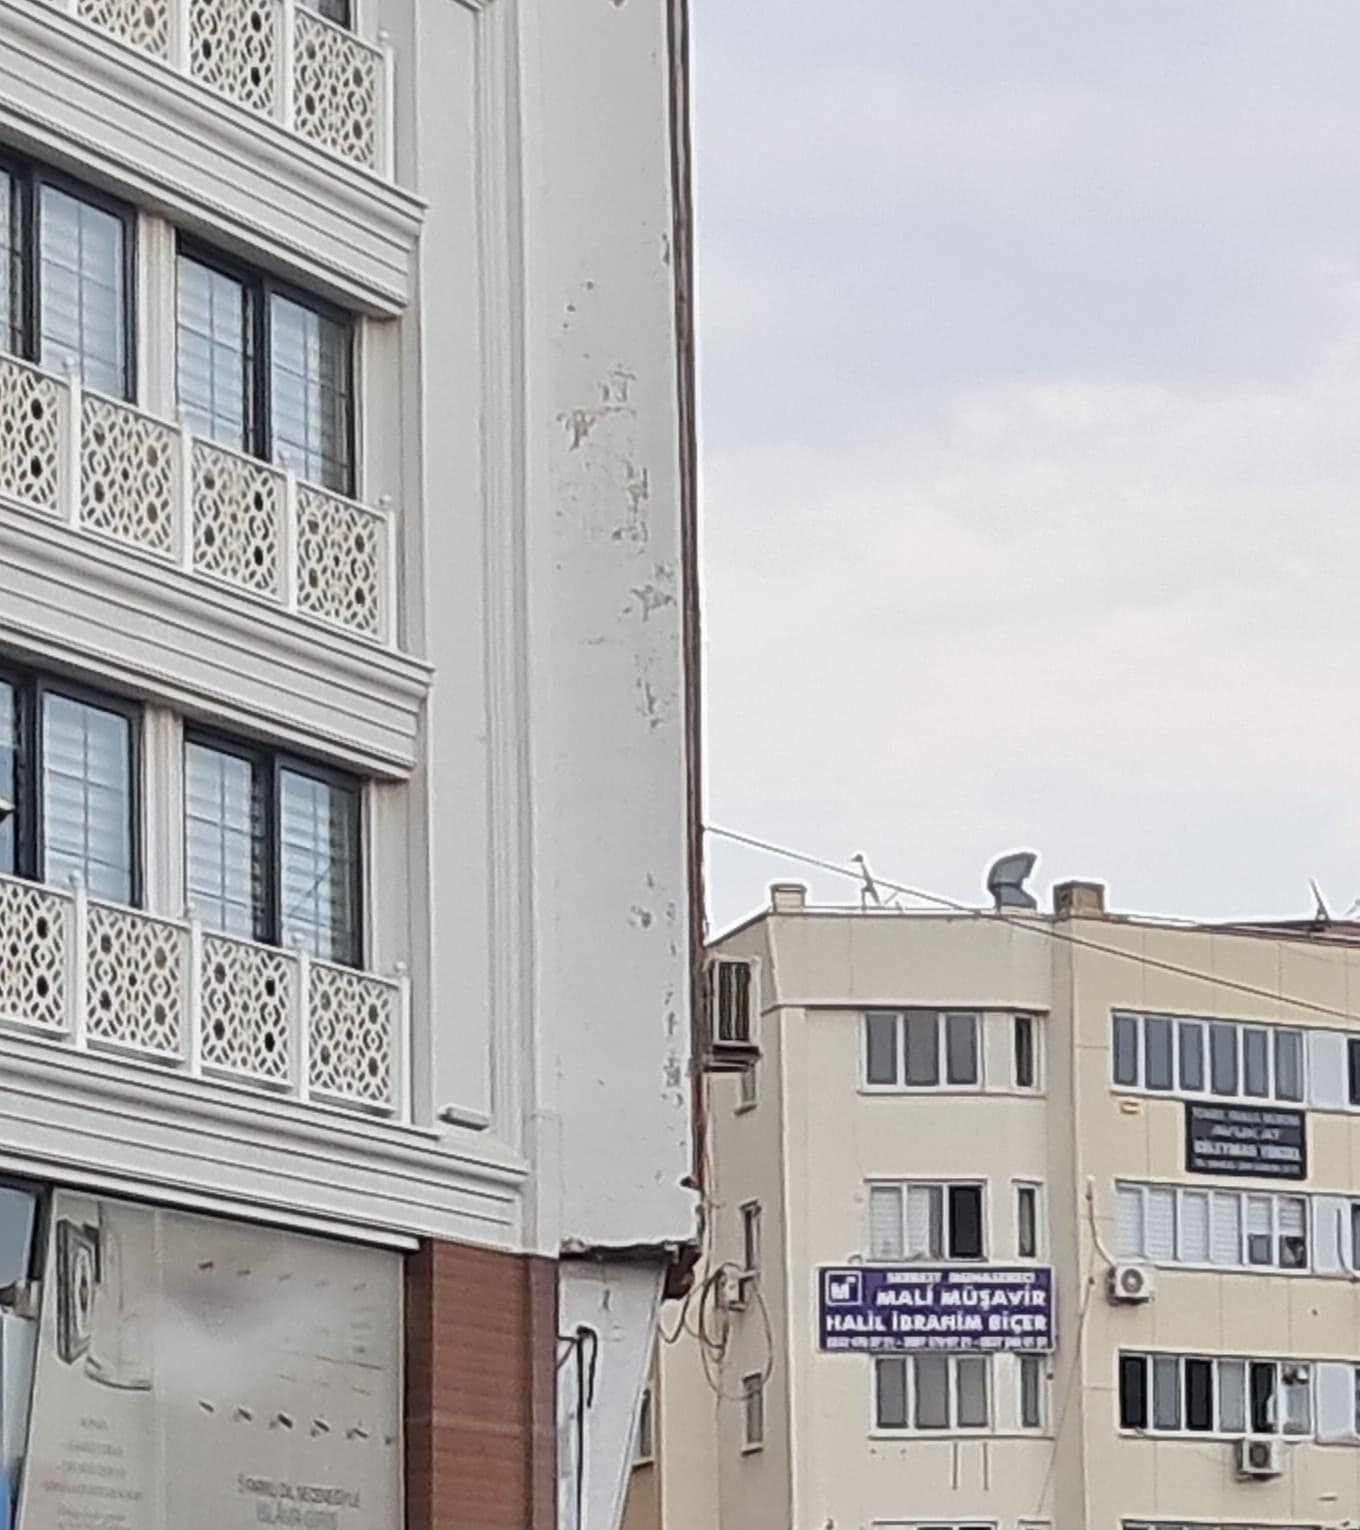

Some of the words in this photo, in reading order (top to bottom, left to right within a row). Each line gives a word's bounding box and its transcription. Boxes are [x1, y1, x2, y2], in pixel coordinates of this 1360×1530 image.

[876, 1285, 934, 1306] MALİ
[940, 1284, 1046, 1310] MÜŞAVİR
[826, 1311, 886, 1331] HALİL
[892, 1311, 983, 1331] İBRAHİM
[988, 1311, 1048, 1334] BİÇER
